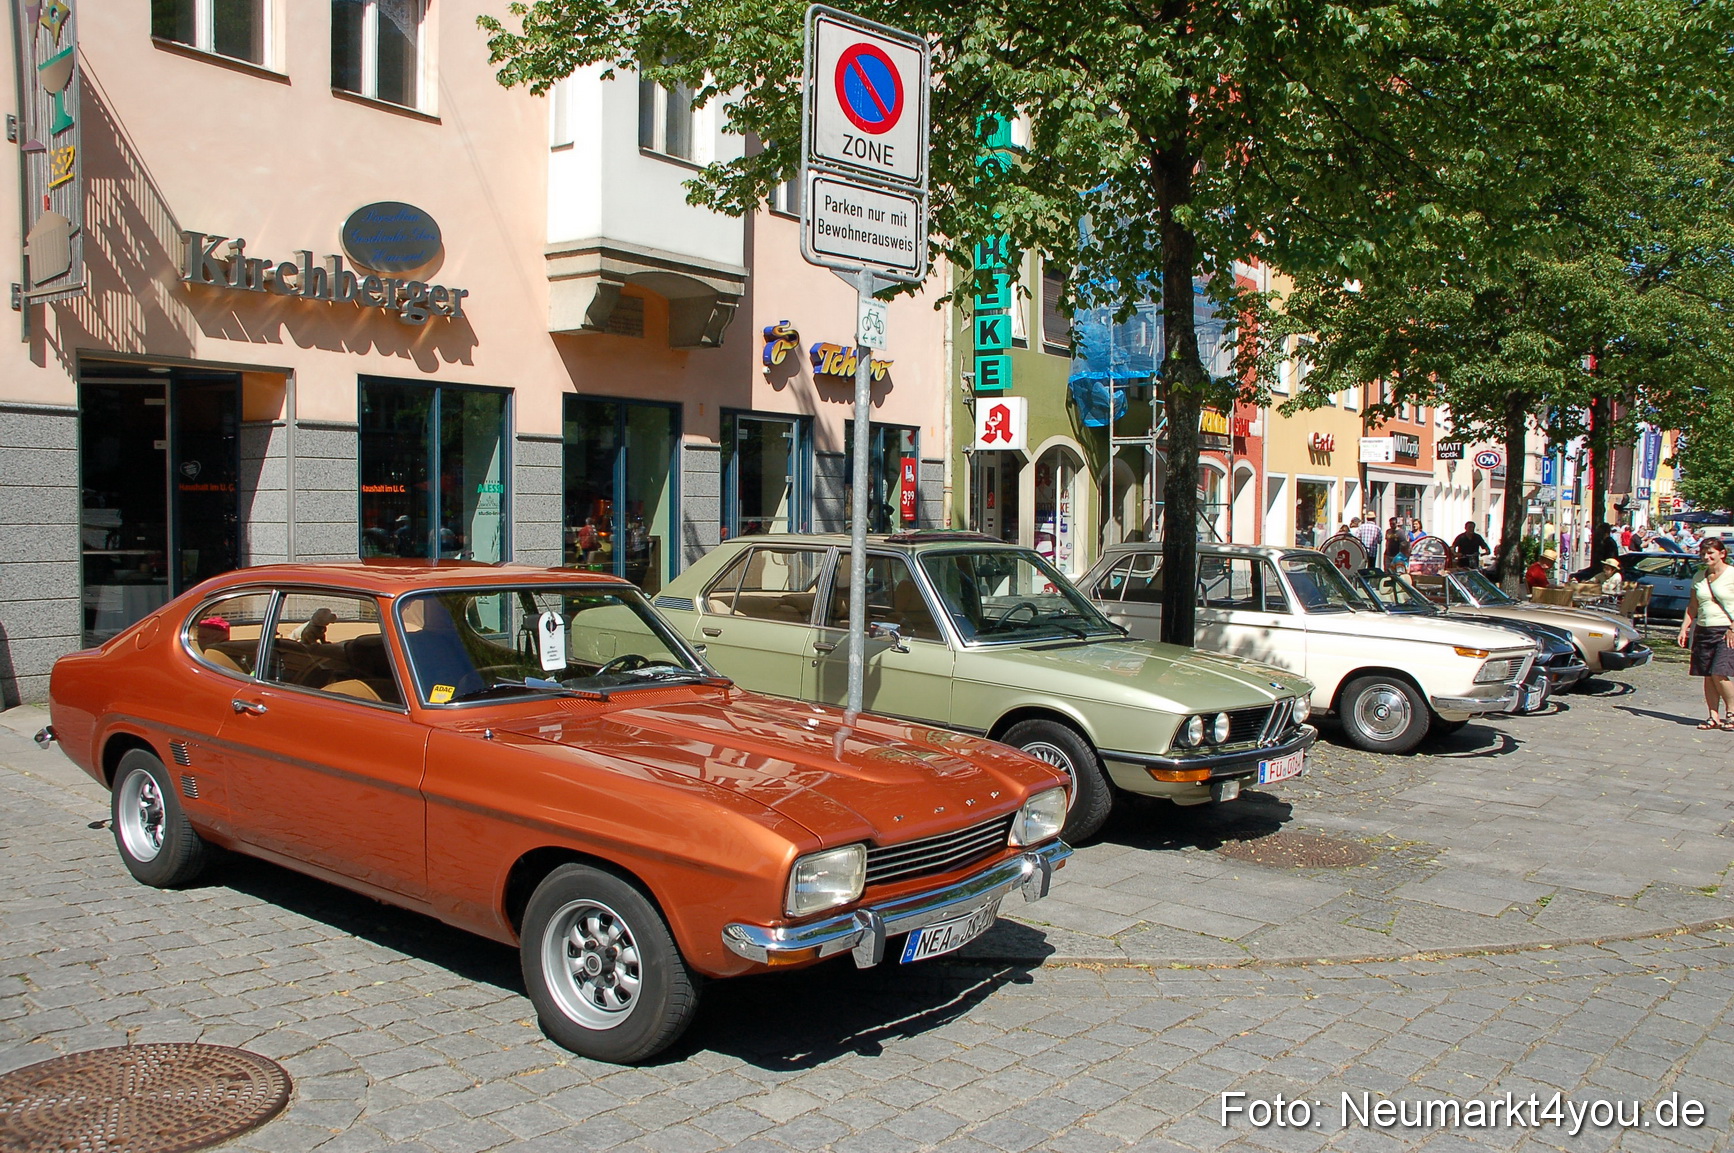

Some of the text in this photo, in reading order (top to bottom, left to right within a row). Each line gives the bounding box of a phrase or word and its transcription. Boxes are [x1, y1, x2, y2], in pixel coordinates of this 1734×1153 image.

[842, 133, 895, 167] ZONE
[825, 195, 908, 228] Parken nur mit
[818, 218, 913, 252] Bewohnerausweis
[180, 230, 469, 325] Kirchberger
[1313, 432, 1335, 452] Café
[1438, 442, 1462, 452] MATT
[1440, 451, 1458, 459] optik
[1543, 460, 1551, 482] P
[385, 484, 393, 493] im
[477, 483, 504, 494] ALESSI
[434, 685, 454, 694] ADAC
[1269, 761, 1282, 780] FÜ
[916, 926, 953, 957] NEA
